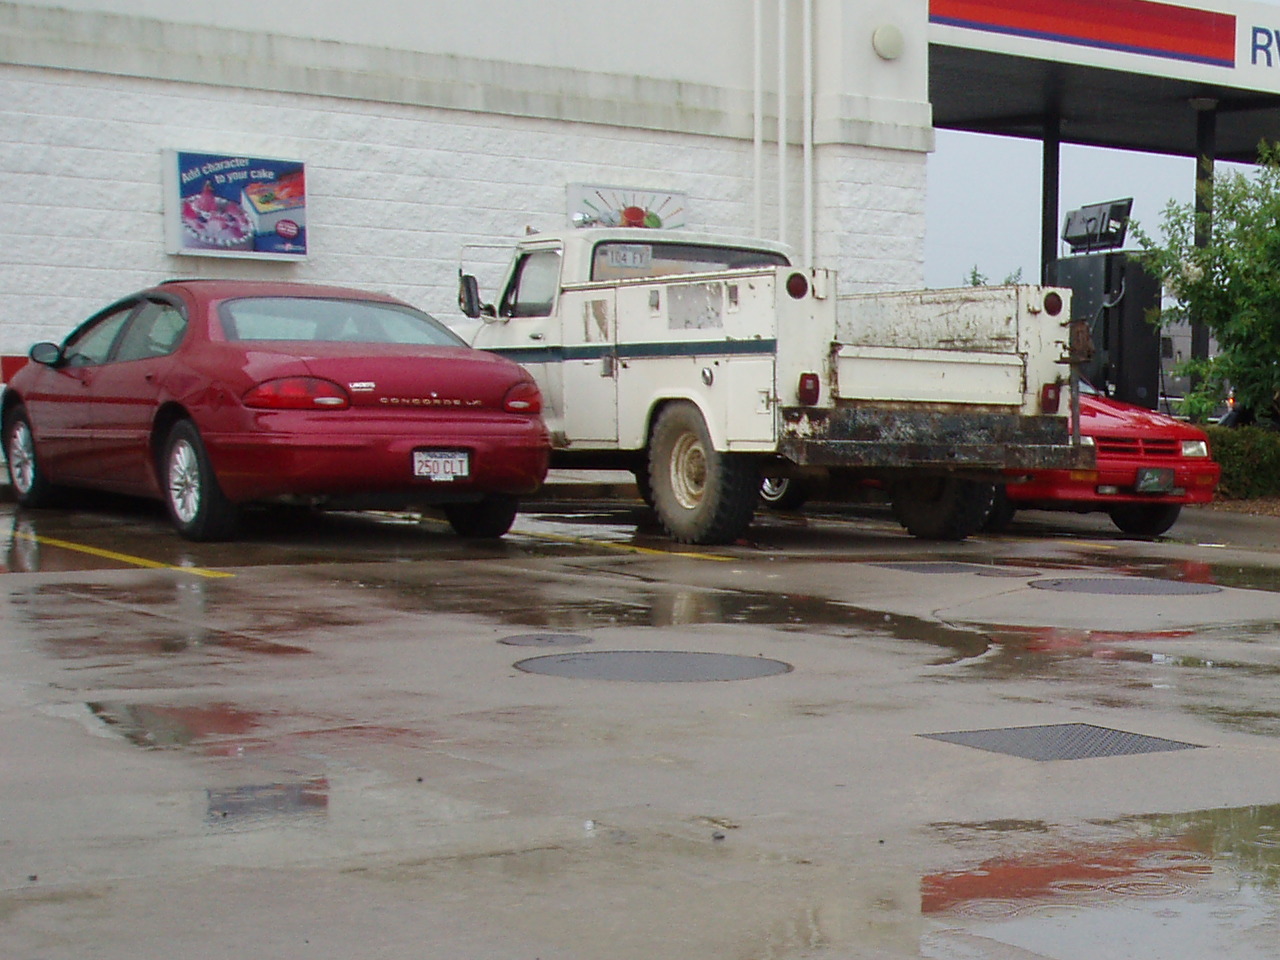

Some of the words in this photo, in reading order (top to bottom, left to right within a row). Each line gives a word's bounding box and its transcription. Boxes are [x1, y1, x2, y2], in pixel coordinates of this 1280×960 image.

[182, 168, 200, 184] Add
[202, 158, 249, 175] character
[215, 174, 225, 184] to
[226, 171, 247, 183] your
[251, 169, 274, 179] cake
[417, 459, 440, 475] 250
[443, 459, 465, 475] CLT
